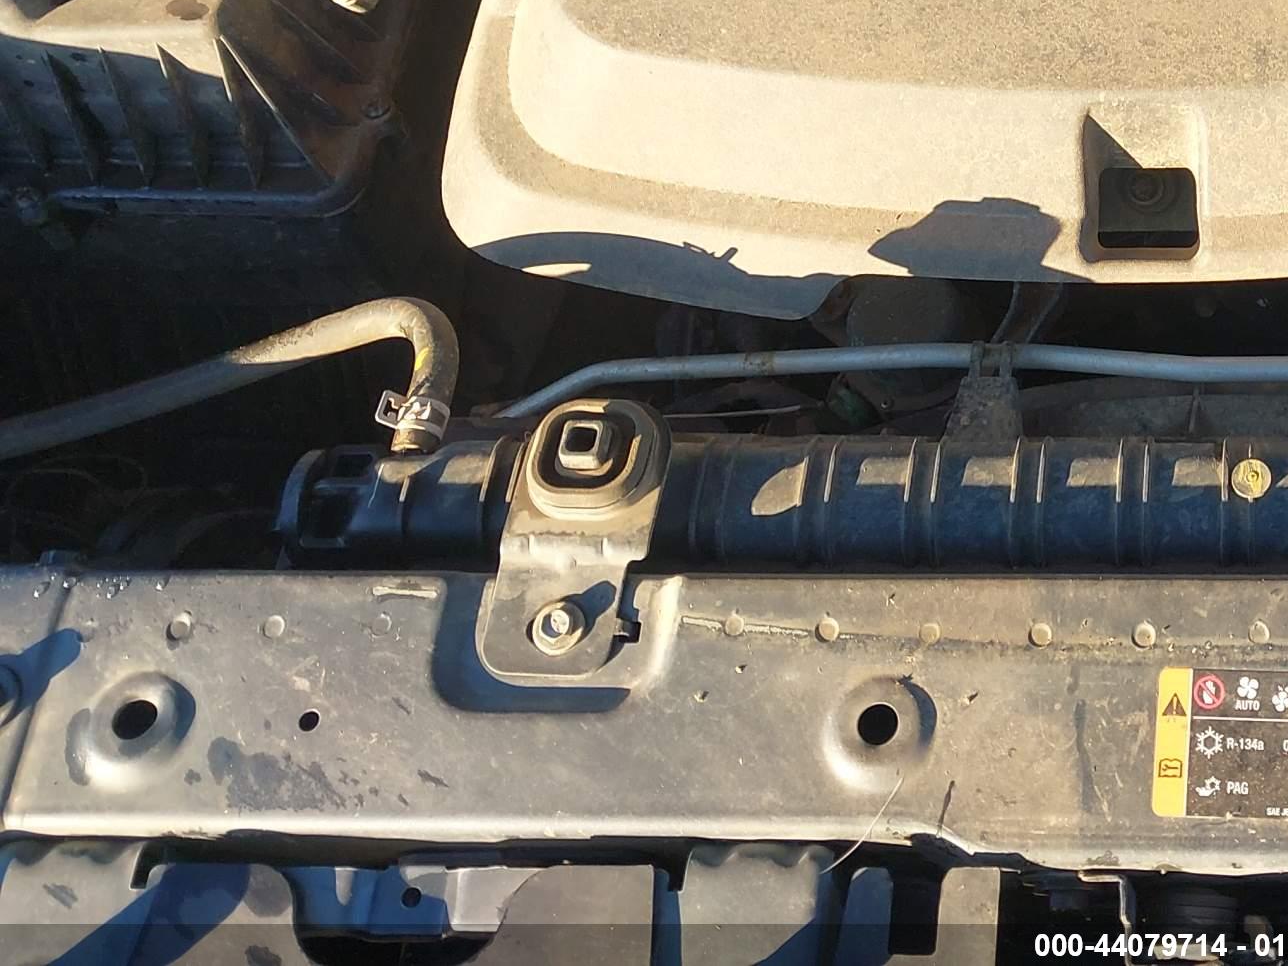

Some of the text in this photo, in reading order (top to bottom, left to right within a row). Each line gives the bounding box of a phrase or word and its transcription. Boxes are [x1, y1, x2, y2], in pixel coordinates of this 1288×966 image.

[1235, 700, 1260, 711] AUTO
[1226, 738, 1265, 750] R-134a
[1226, 782, 1249, 795] PAG
[1266, 807, 1281, 816] SAE
